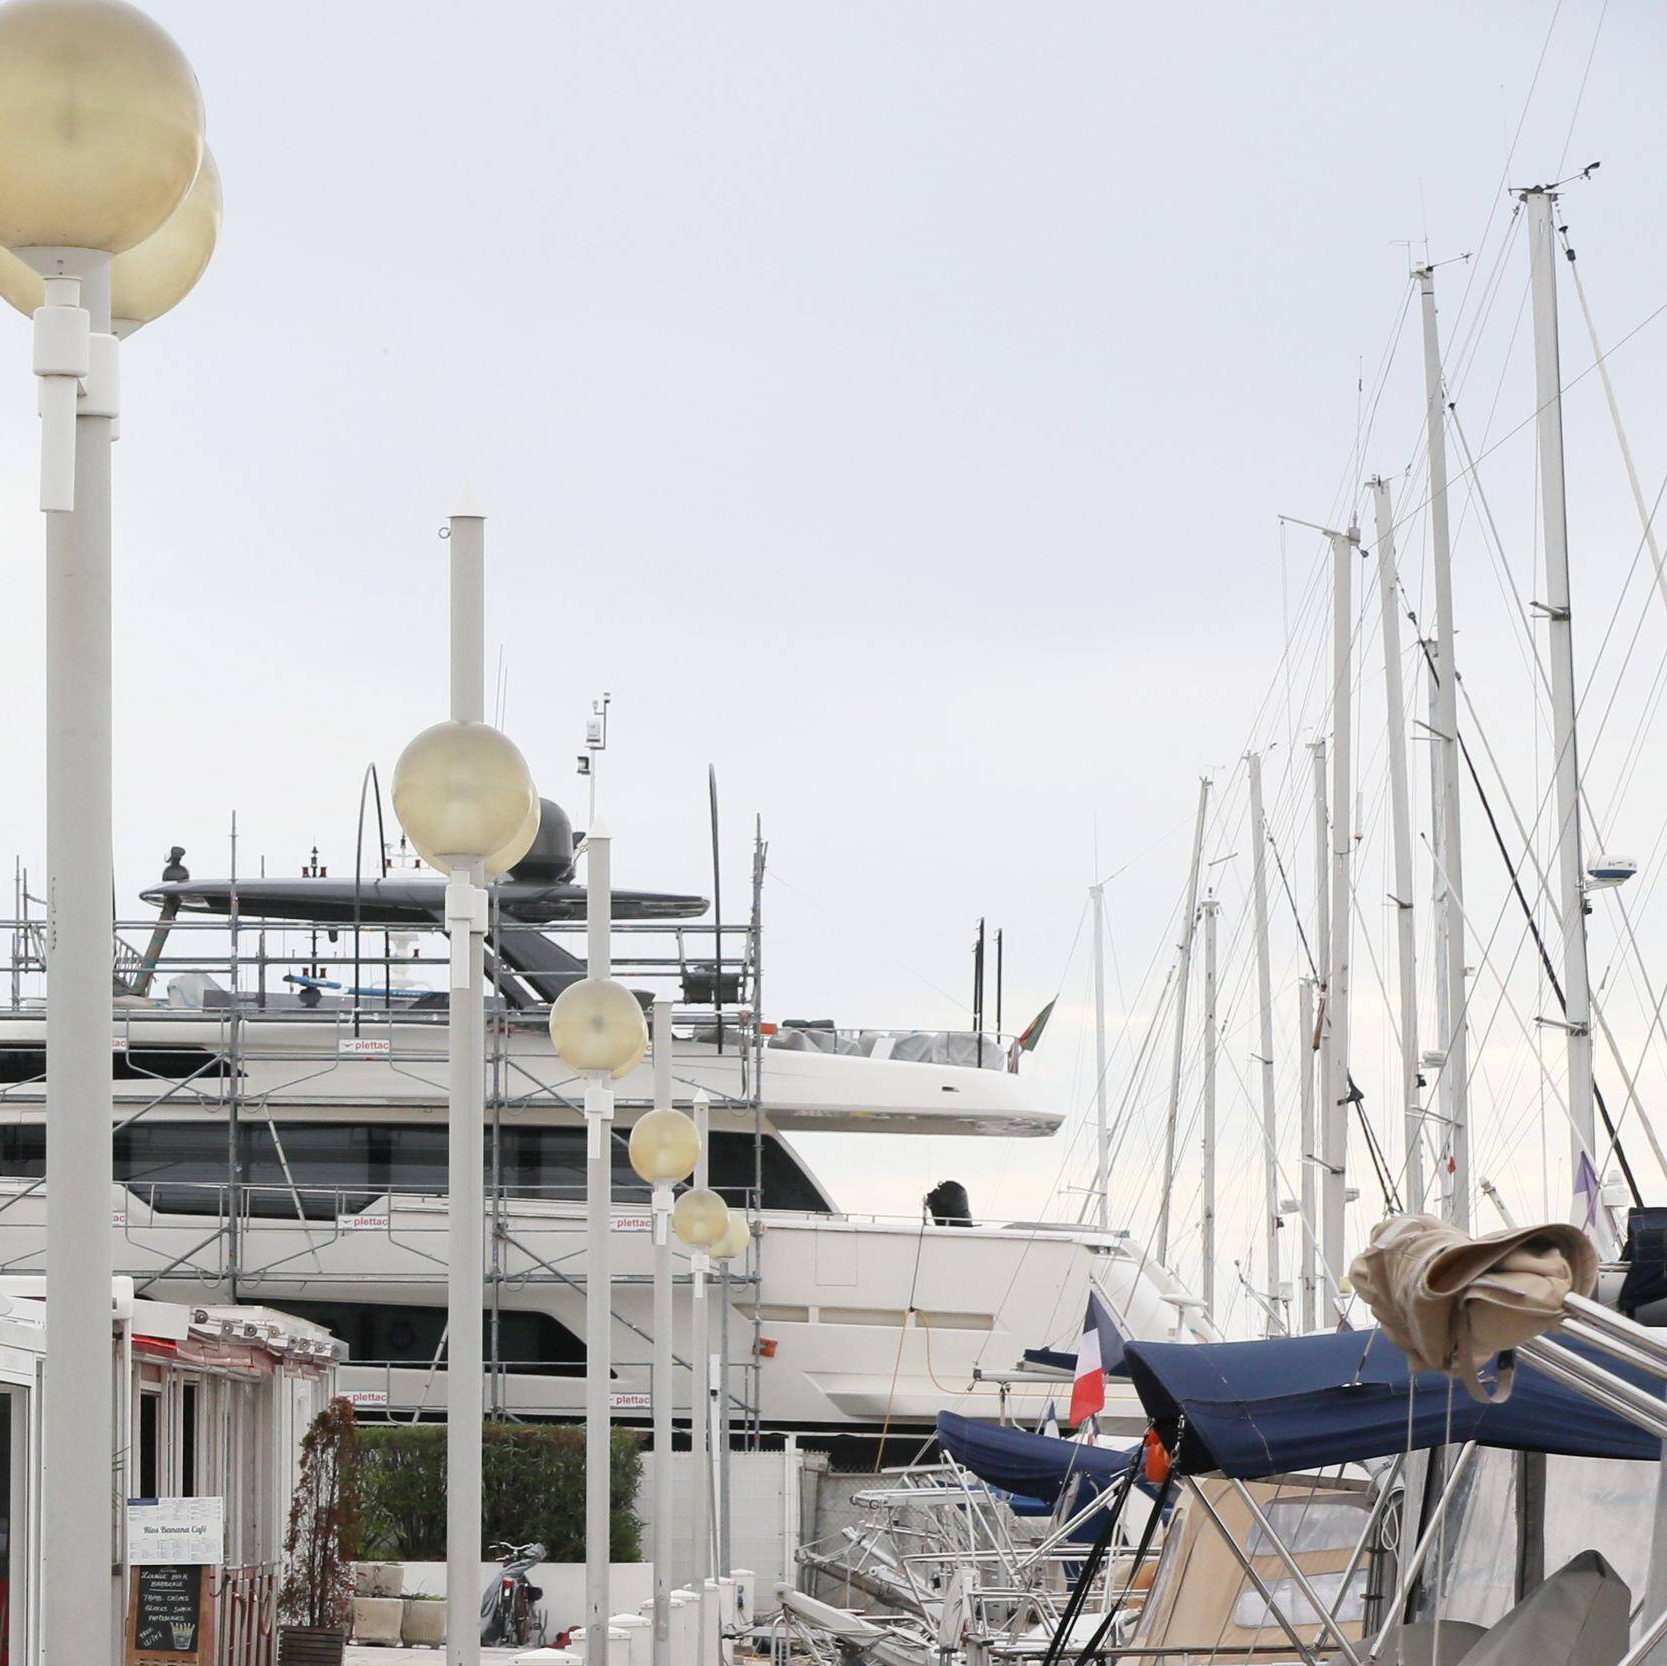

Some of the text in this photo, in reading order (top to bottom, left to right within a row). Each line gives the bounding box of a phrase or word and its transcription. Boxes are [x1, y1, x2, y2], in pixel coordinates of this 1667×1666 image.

[355, 1040, 389, 1050] plettac
[354, 1217, 388, 1227] plettac
[617, 1218, 652, 1228] plettac
[352, 1392, 387, 1402] plettac
[616, 1395, 650, 1405] plettac
